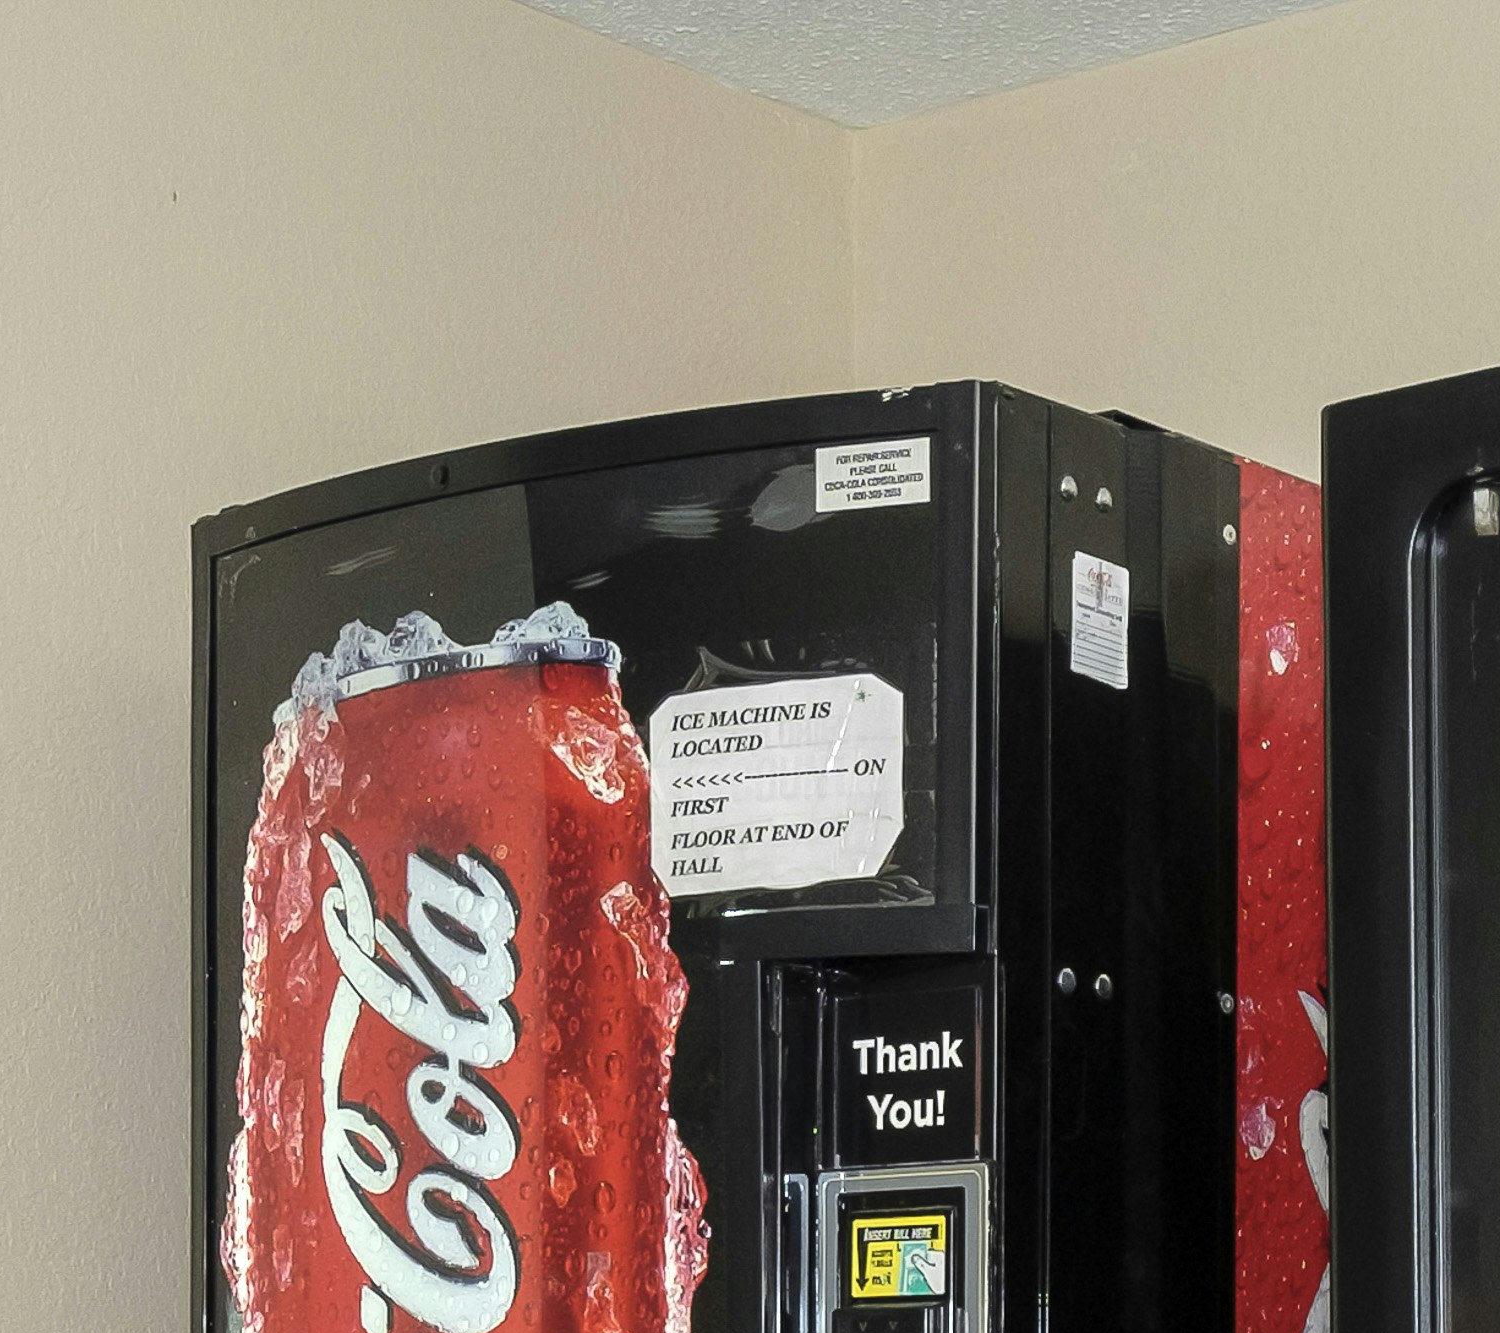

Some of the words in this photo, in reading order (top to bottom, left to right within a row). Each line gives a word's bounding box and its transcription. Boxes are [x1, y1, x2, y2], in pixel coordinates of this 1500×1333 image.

[850, 464, 876, 476] PLEASE
[879, 463, 897, 473] CALL
[867, 473, 923, 487] CONSOLIDATED
[671, 712, 704, 731] ICE
[708, 704, 805, 728] MACHINE
[810, 701, 832, 719] IS
[671, 735, 763, 759] LOCATED
[854, 758, 886, 776] ON
[671, 796, 729, 818] FIRST
[671, 829, 736, 850] FLOOR
[739, 826, 768, 844] AT
[772, 823, 814, 841] END
[820, 821, 849, 839] OF
[671, 857, 723, 877] HALL
[852, 1032, 963, 1076] Thank
[867, 1090, 945, 1130] You!
[863, 1228, 892, 1241] INSERT
[894, 1228, 909, 1240] BILL
[911, 1227, 933, 1239] HERE
